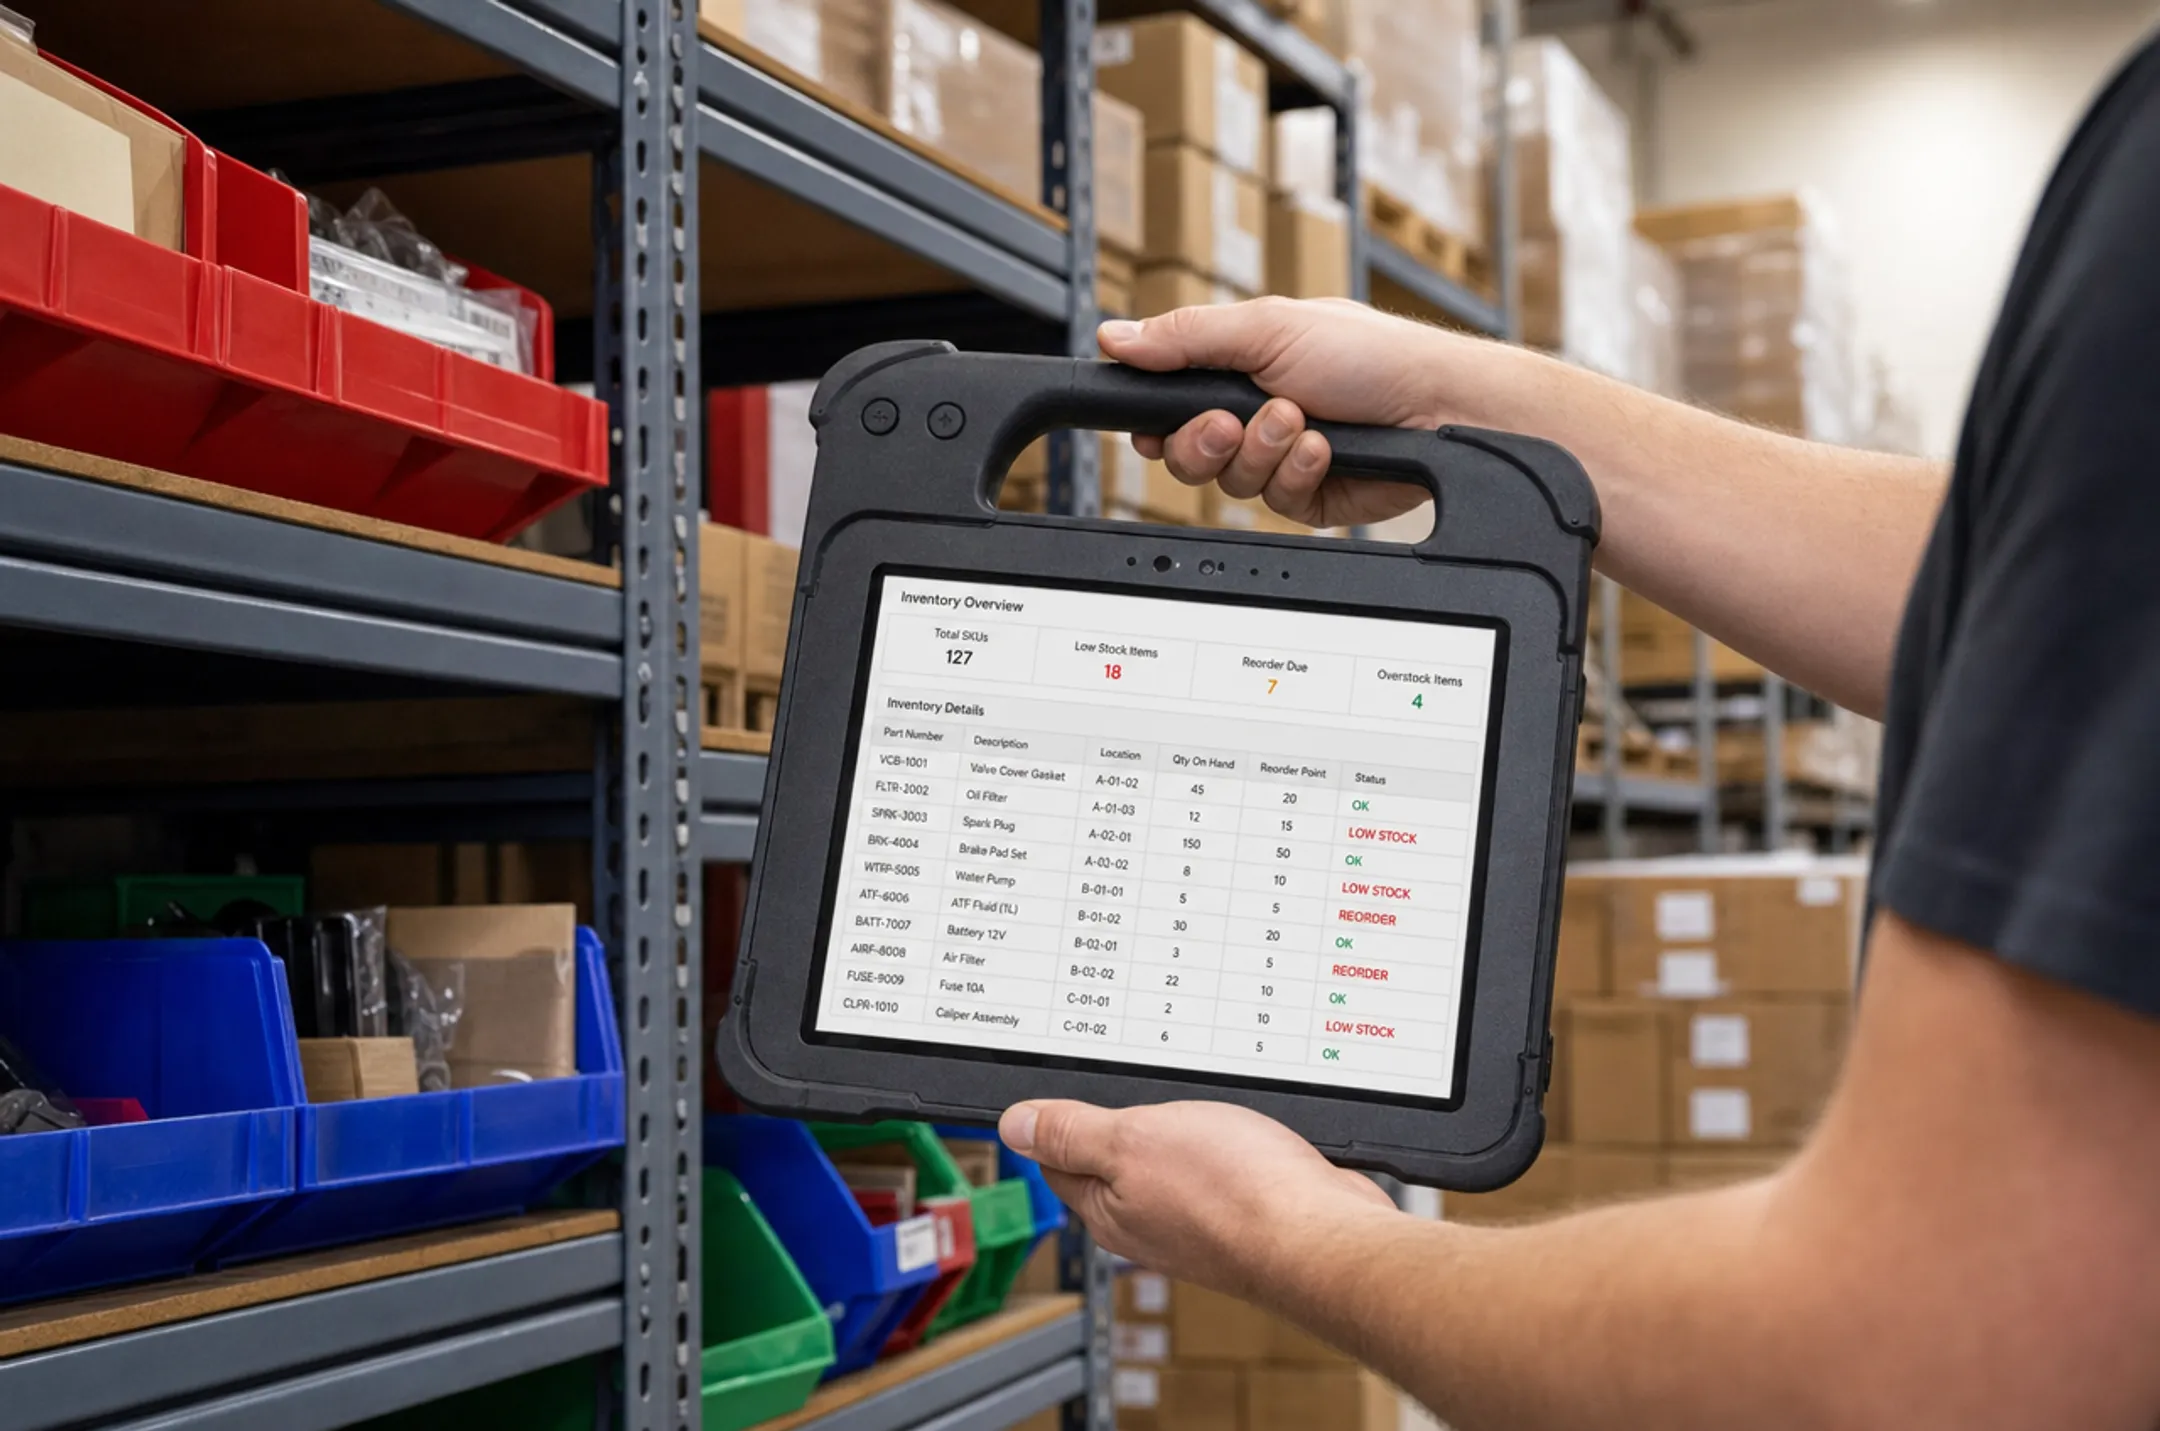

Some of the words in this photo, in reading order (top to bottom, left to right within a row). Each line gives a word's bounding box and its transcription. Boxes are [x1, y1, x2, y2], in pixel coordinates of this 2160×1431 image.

[900, 590, 962, 610] Inventory
[963, 595, 1024, 613] Overview
[934, 627, 961, 640] Total
[961, 629, 989, 643] SKUs
[945, 649, 974, 666] 127
[1074, 641, 1097, 652] Low
[1098, 642, 1128, 656] Stock
[1129, 646, 1159, 659] Items
[1104, 663, 1122, 681] 18
[1241, 656, 1285, 671] Reorder
[1286, 659, 1309, 673] Due
[1376, 668, 1431, 685] Overstock
[1433, 673, 1463, 688] Items
[1267, 678, 1279, 695] 7
[887, 696, 943, 715] Inventory
[944, 701, 985, 717] Details
[1410, 693, 1424, 710] 4
[883, 726, 904, 738] Part
[904, 728, 944, 742] Number
[973, 735, 1029, 750] Description
[879, 754, 928, 768] VCB-1001
[1100, 747, 1142, 761] Location
[1172, 753, 1191, 768] Qty
[1191, 755, 1208, 767] On
[1208, 757, 1236, 770] Hand
[970, 762, 997, 775] Valve
[999, 765, 1029, 778] Cover
[1030, 768, 1066, 782] Gasket
[1260, 761, 1299, 776] Reorder
[1300, 766, 1327, 779] Point
[1095, 774, 1139, 790] A-01-02
[1354, 772, 1387, 786] Status
[965, 789, 981, 800] Oil
[982, 790, 1008, 803] Filter
[1190, 784, 1205, 796] 45
[1282, 792, 1298, 805] 20
[1351, 799, 1370, 812] OK
[1091, 801, 1136, 816] A-01-03
[962, 815, 991, 829] Spark
[993, 818, 1016, 834] Plug
[1189, 811, 1201, 823] 12
[1281, 820, 1293, 832] 15
[867, 833, 919, 849] BRK-4004
[1088, 828, 1132, 843] A-02-01
[1182, 837, 1202, 850] 150
[1348, 826, 1377, 840] LOW
[1378, 829, 1417, 845] STOCK
[958, 842, 988, 857] Brake
[988, 845, 1009, 859] Pad
[1010, 848, 1028, 860] Set
[1275, 846, 1291, 859] 50
[1344, 854, 1363, 867] OK
[1182, 865, 1191, 877] 8
[955, 870, 986, 883] Water
[986, 872, 1016, 889] Pump
[1273, 874, 1287, 887] 10
[858, 888, 910, 904] ATF-6006
[1081, 882, 1124, 897] B-01-01
[1341, 881, 1370, 895] LOW
[1371, 884, 1411, 900] STOCK
[950, 897, 972, 909] ATF
[972, 899, 998, 913] Fluid
[1179, 892, 1187, 905] 5
[1272, 902, 1281, 914] 5
[855, 914, 912, 931] BATT-7007
[1077, 909, 1122, 925] B-01-02
[1338, 909, 1397, 927] REORDER
[946, 924, 985, 941] Battery
[987, 929, 1007, 941] 12V
[1172, 919, 1188, 932] 30
[1265, 929, 1281, 942] 20
[1334, 936, 1354, 950] OK
[1073, 936, 1118, 952] B-02-01
[942, 951, 958, 963] Air
[959, 953, 986, 966] Filter
[1172, 946, 1180, 959] 3
[1265, 956, 1274, 969] 5
[846, 969, 905, 986] FUSE-9009
[1070, 964, 1115, 980] B-02-02
[1331, 963, 1389, 981] REORDER
[939, 978, 964, 993] Fuse
[966, 982, 985, 994] 10A
[1165, 974, 1180, 987] 22
[1261, 985, 1274, 997] 10
[1328, 992, 1347, 1005] OK
[842, 997, 899, 1014] CLPR-1010
[1066, 992, 1110, 1007] C-01-01
[1164, 1002, 1173, 1014] 2
[934, 1006, 971, 1022] Caliper
[971, 1011, 1020, 1029] Assembly
[1257, 1012, 1270, 1025] 10
[1063, 1020, 1107, 1036] C-01-02
[1325, 1020, 1354, 1034] LOW
[1355, 1023, 1396, 1039] STOCK
[1160, 1030, 1169, 1043] 6
[1255, 1040, 1264, 1053] 5
[1321, 1047, 1341, 1061] OK
